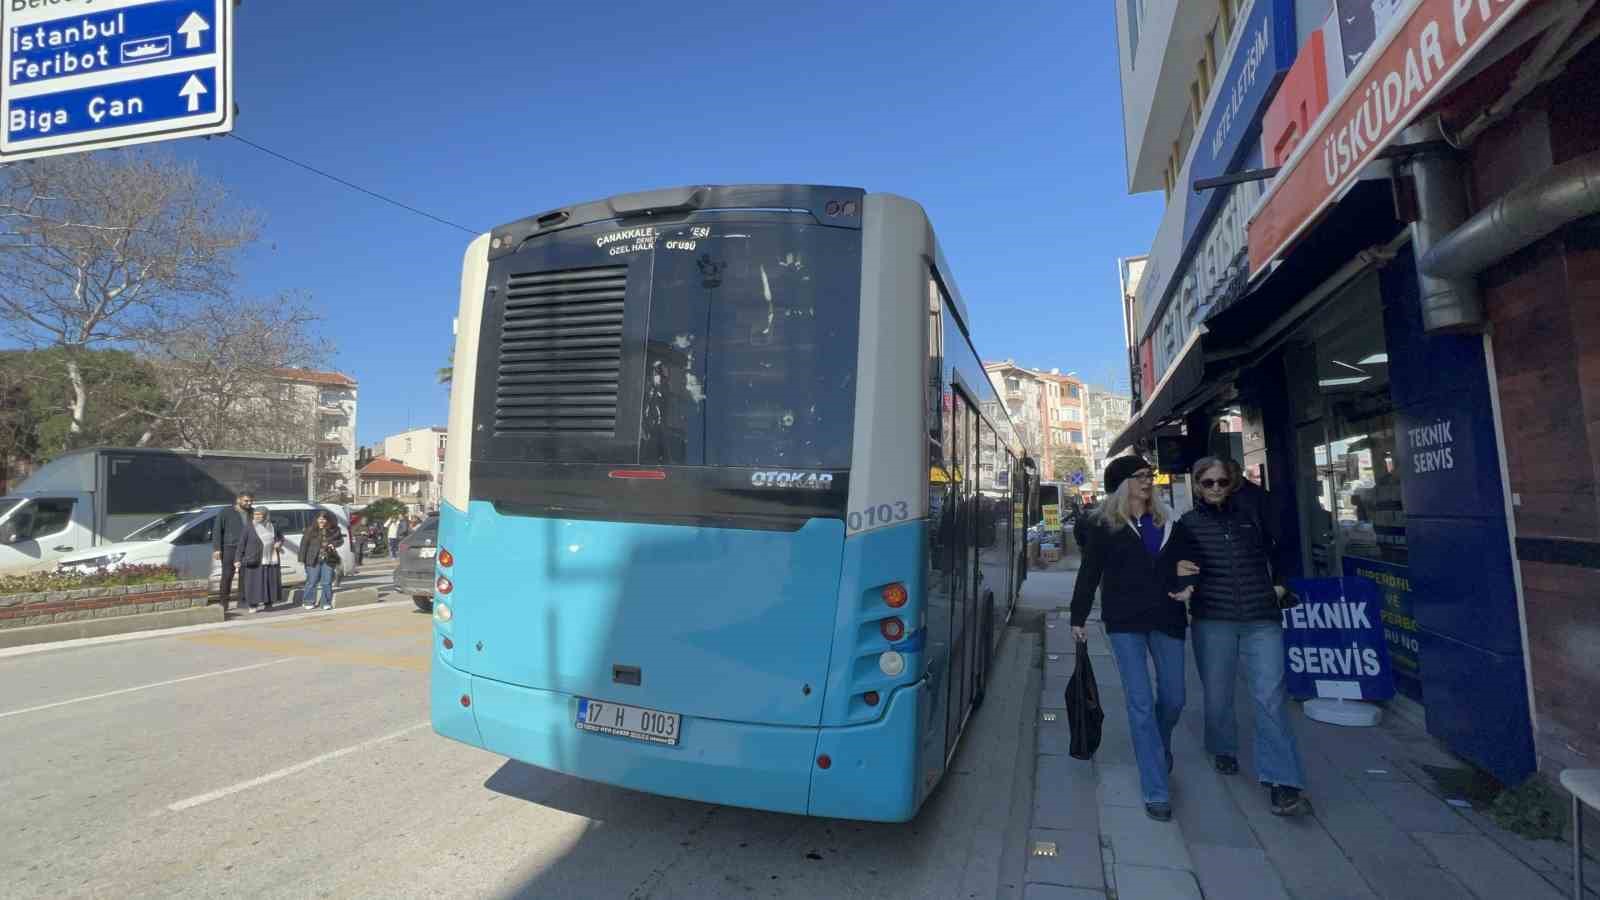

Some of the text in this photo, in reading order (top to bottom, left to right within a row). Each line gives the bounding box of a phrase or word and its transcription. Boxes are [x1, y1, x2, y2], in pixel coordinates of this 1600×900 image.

[13, 13, 124, 52] İstanbul
[13, 45, 109, 80] Feribot
[9, 97, 143, 132] Biga Çan
[1324, 20, 1445, 186] ÜSKÜDAR
[597, 227, 653, 247] ÇANAKKALE
[1408, 418, 1453, 449] TEKNİK
[751, 471, 833, 489] OTOKAR
[848, 500, 909, 531] 0103
[1281, 596, 1373, 629] TEKNİK
[1288, 640, 1381, 676] SERVİS
[588, 703, 603, 723] 17
[615, 707, 625, 727] H
[641, 711, 675, 735] 0103
